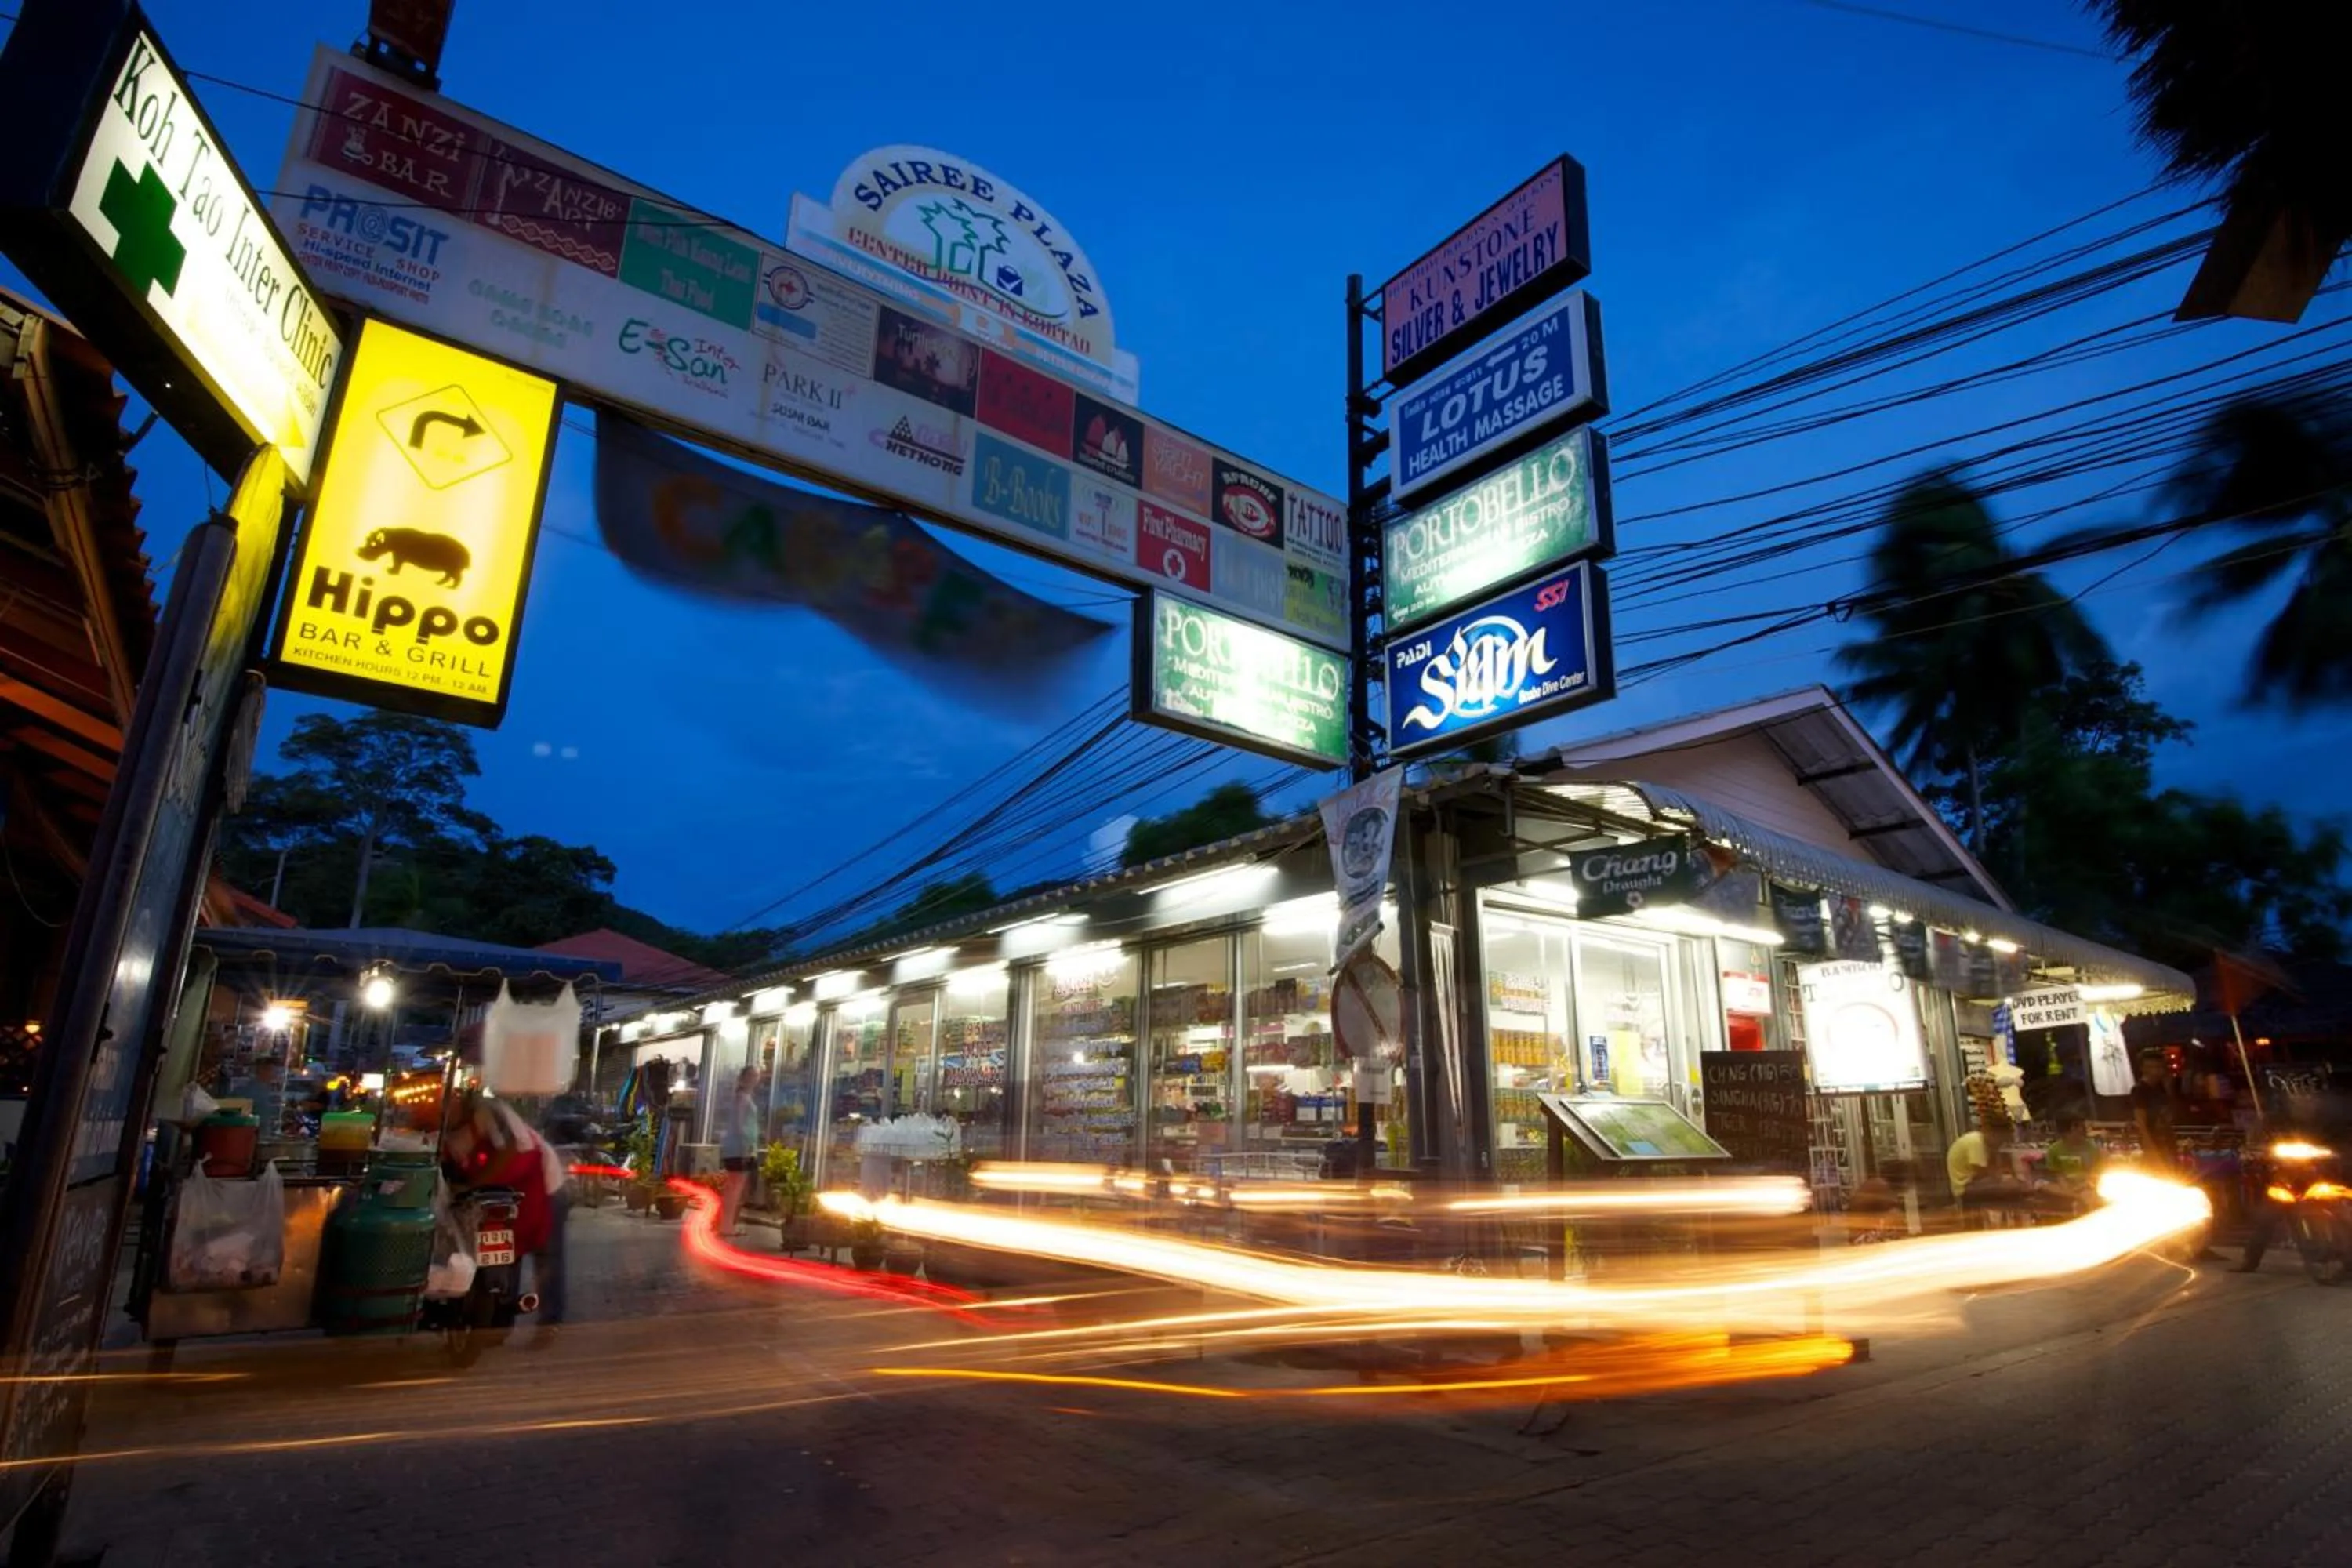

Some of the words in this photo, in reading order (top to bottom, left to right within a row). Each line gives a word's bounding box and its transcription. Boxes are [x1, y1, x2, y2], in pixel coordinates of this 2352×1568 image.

[377, 149, 452, 198] BAR
[114, 39, 177, 168] Koh
[178, 129, 223, 237] Tao
[226, 202, 280, 316] Inter
[281, 284, 333, 390] Clinic
[854, 159, 995, 212] SAIREE
[1009, 199, 1100, 319] PLAZA
[297, 222, 376, 259] SERVICE
[396, 258, 440, 281] SHOP
[848, 227, 928, 277] CENTER
[375, 262, 431, 292] Internet
[1391, 301, 1444, 365] SILVER
[1451, 289, 1465, 325] &
[1475, 221, 1559, 311] JEWELRY
[1520, 330, 1539, 350] 20
[1542, 317, 1559, 338] M
[763, 363, 824, 404] PARK
[1421, 345, 1548, 442] LOTUS
[1409, 427, 1468, 477] HEALTH
[1474, 373, 1564, 441] MASSAGE
[1287, 491, 1344, 554] TATTOO
[1392, 448, 1576, 572] PORTOBELLO
[1515, 497, 1570, 533] BISTRO
[307, 565, 499, 646] Hippo
[293, 646, 352, 666] KITCHEN
[355, 657, 401, 677] HOURS
[406, 670, 417, 681] 12
[452, 679, 464, 690] 12
[467, 683, 488, 694] AM
[299, 622, 361, 650] BAR
[376, 639, 392, 657] &
[407, 646, 491, 678] GRILL
[1396, 640, 1432, 669] PADI
[1541, 679, 1559, 698] Dive
[1559, 671, 1584, 689] Center
[1582, 851, 1677, 882] Chang
[1602, 875, 1662, 894] Draught
[2013, 996, 2035, 1009] DVD
[2037, 990, 2082, 1006] PLAYE
[2021, 1012, 2043, 1025] FOR
[2045, 1007, 2078, 1022] RENT
